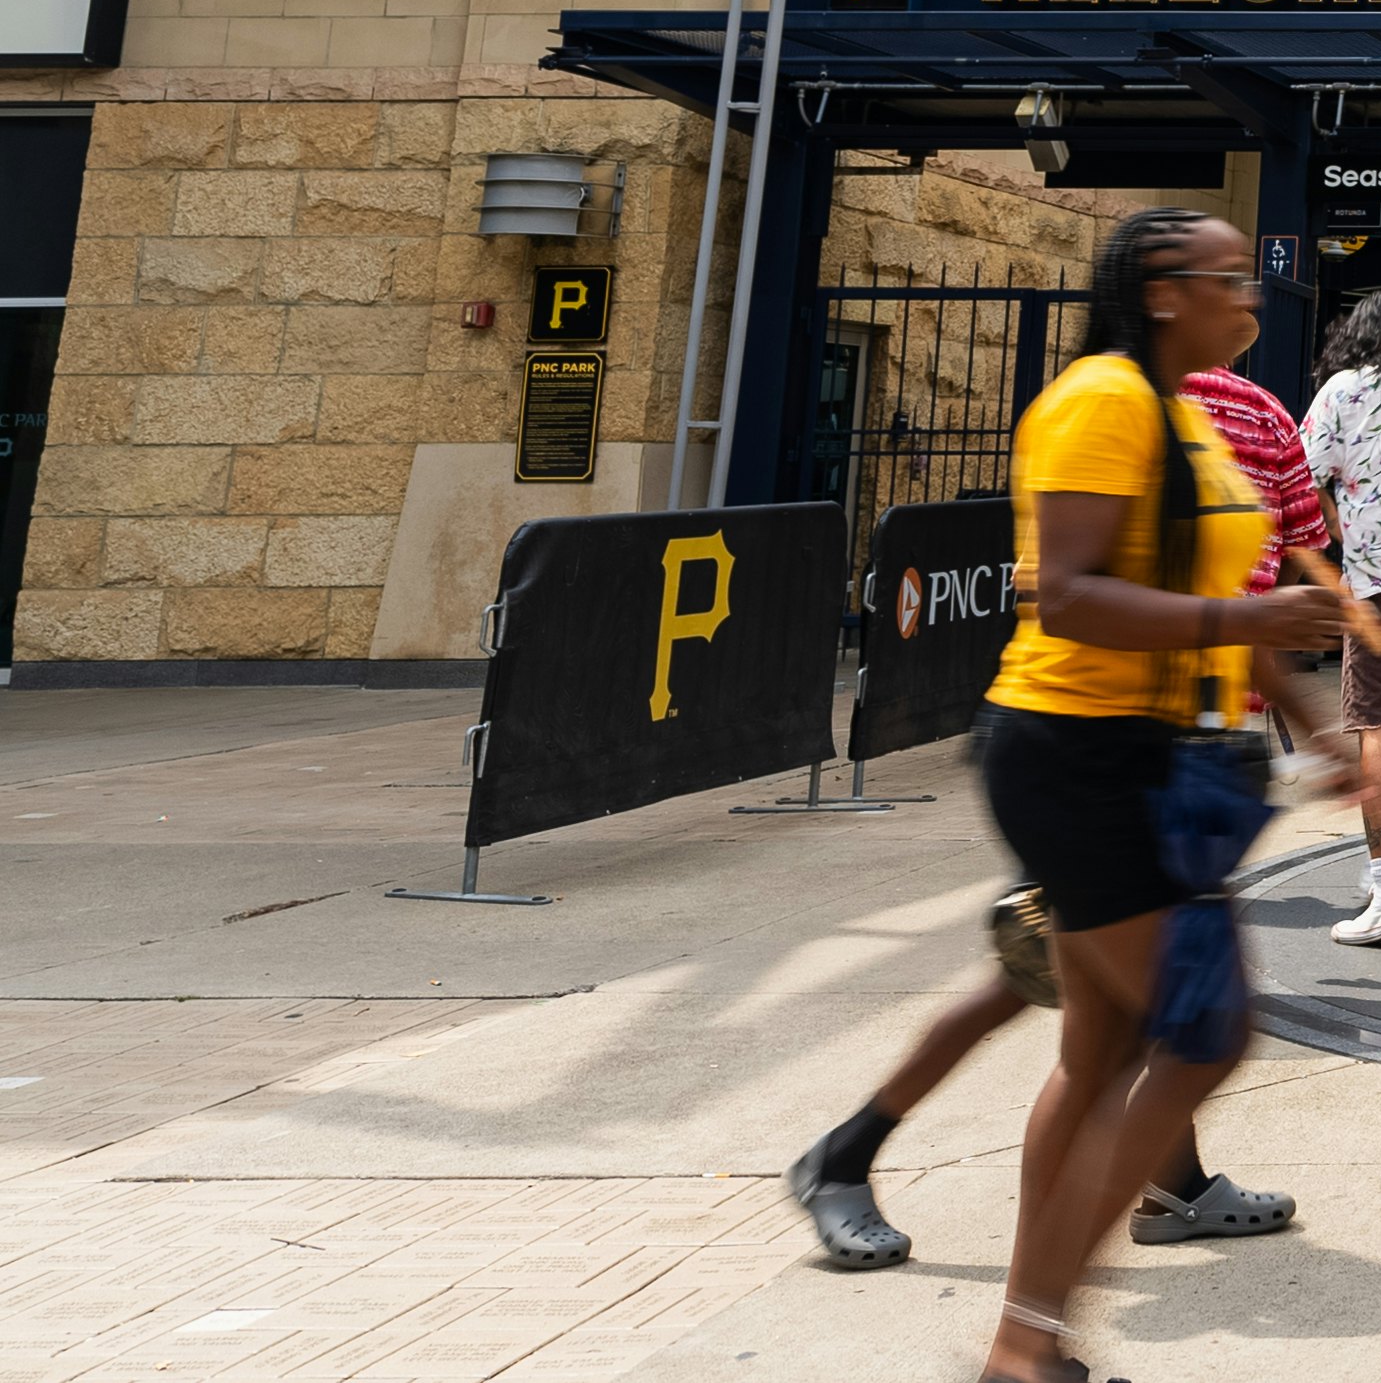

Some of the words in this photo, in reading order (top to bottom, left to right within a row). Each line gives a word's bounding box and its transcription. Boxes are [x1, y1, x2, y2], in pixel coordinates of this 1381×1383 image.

[1335, 209, 1367, 217] ROTUNDA
[549, 280, 589, 329] P
[532, 363, 559, 373] PNC
[561, 363, 597, 373] PARK
[928, 565, 993, 626] PNC
[649, 529, 736, 722] P
